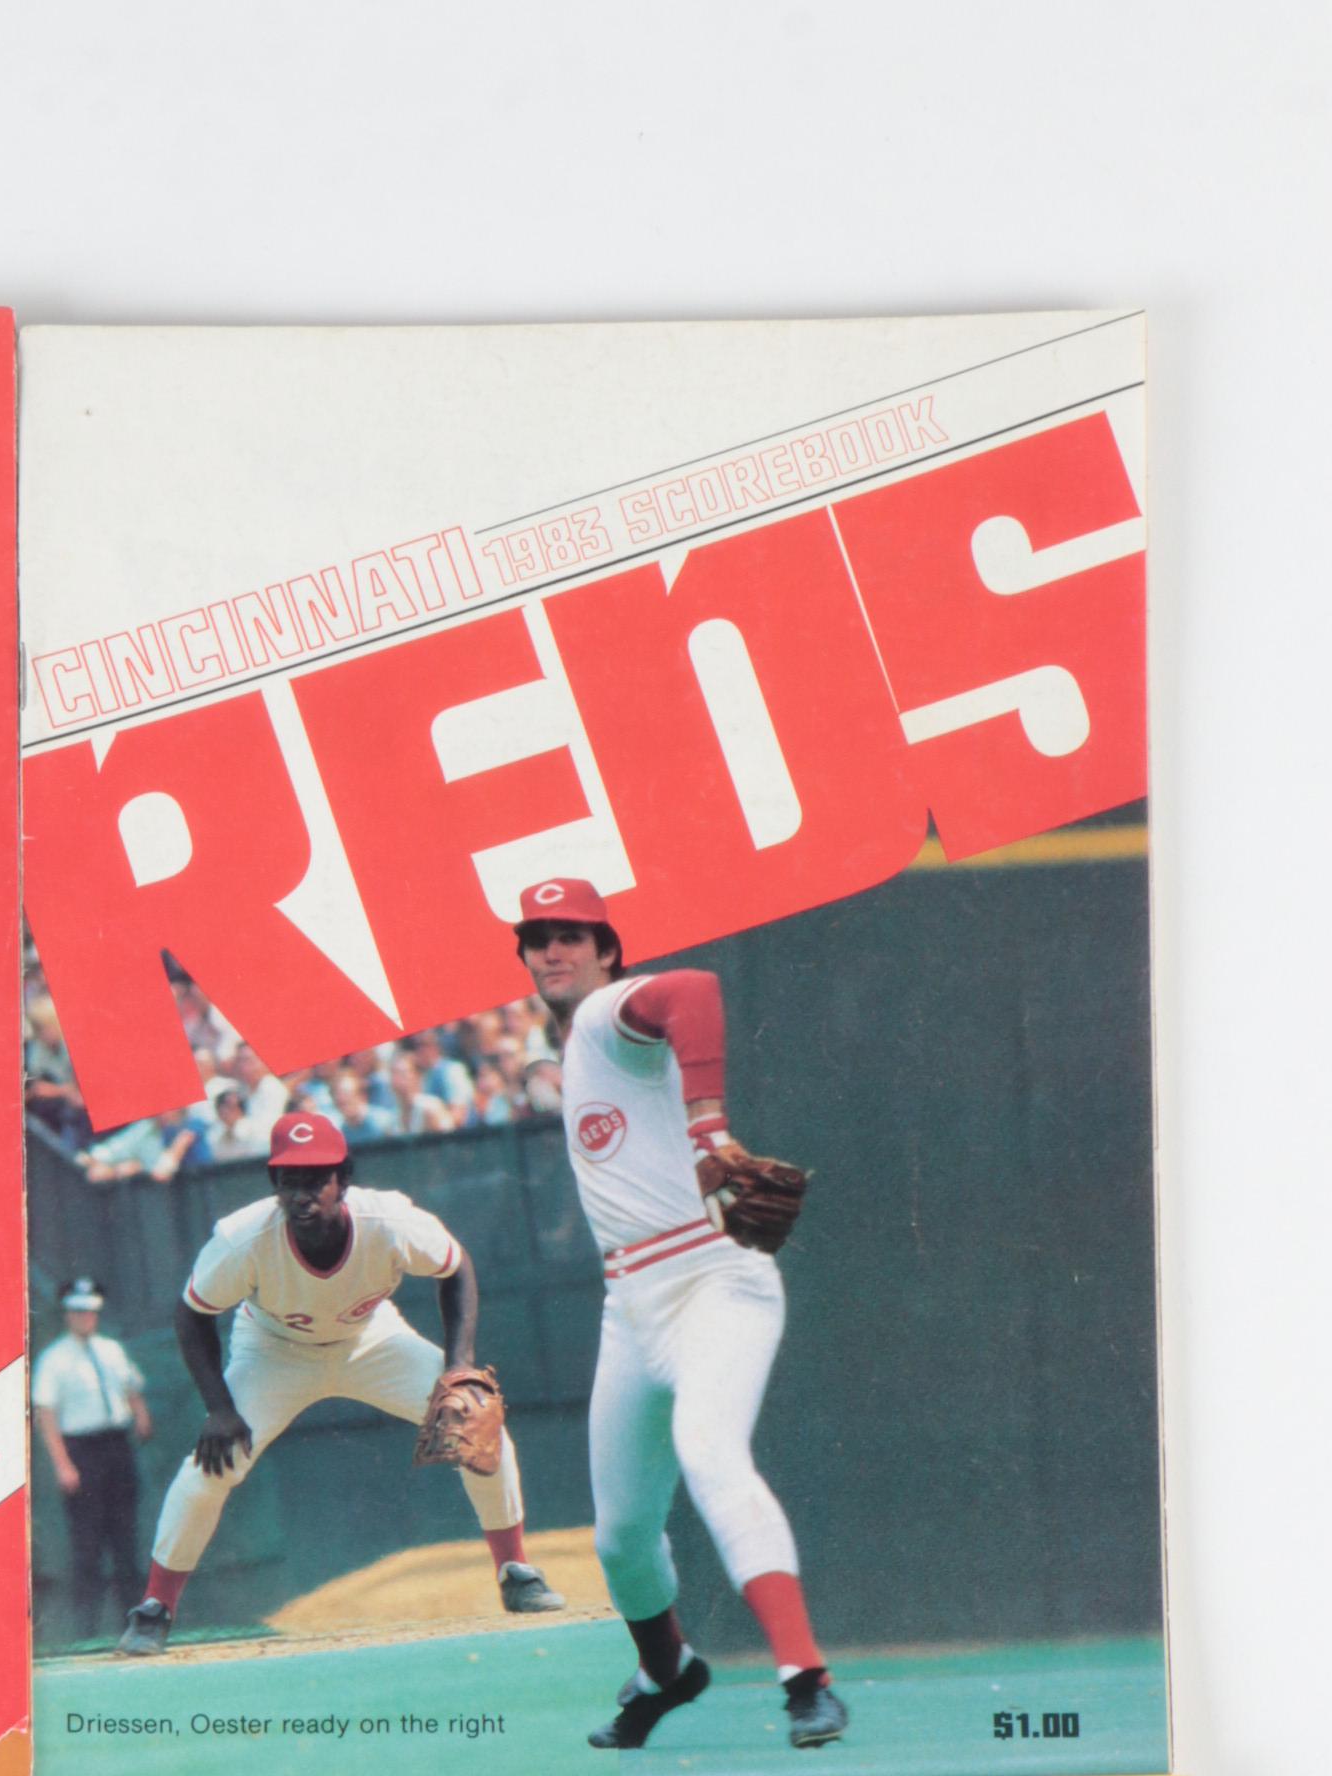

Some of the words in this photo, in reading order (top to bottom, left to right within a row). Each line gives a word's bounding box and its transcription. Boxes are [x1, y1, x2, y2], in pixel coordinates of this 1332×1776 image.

[32, 526, 484, 730] CINCINNATI
[482, 505, 614, 588] 1983
[619, 396, 949, 545] SCOREBOOK
[22, 410, 1147, 1132] REDS
[580, 1111, 622, 1147] REDS
[66, 1712, 181, 1737] Driessen,
[190, 1712, 273, 1735] Oester
[282, 1713, 350, 1738] ready
[359, 1718, 391, 1734] on
[399, 1713, 439, 1734] the
[448, 1713, 506, 1738] right
[992, 1711, 1080, 1740] $1.00
